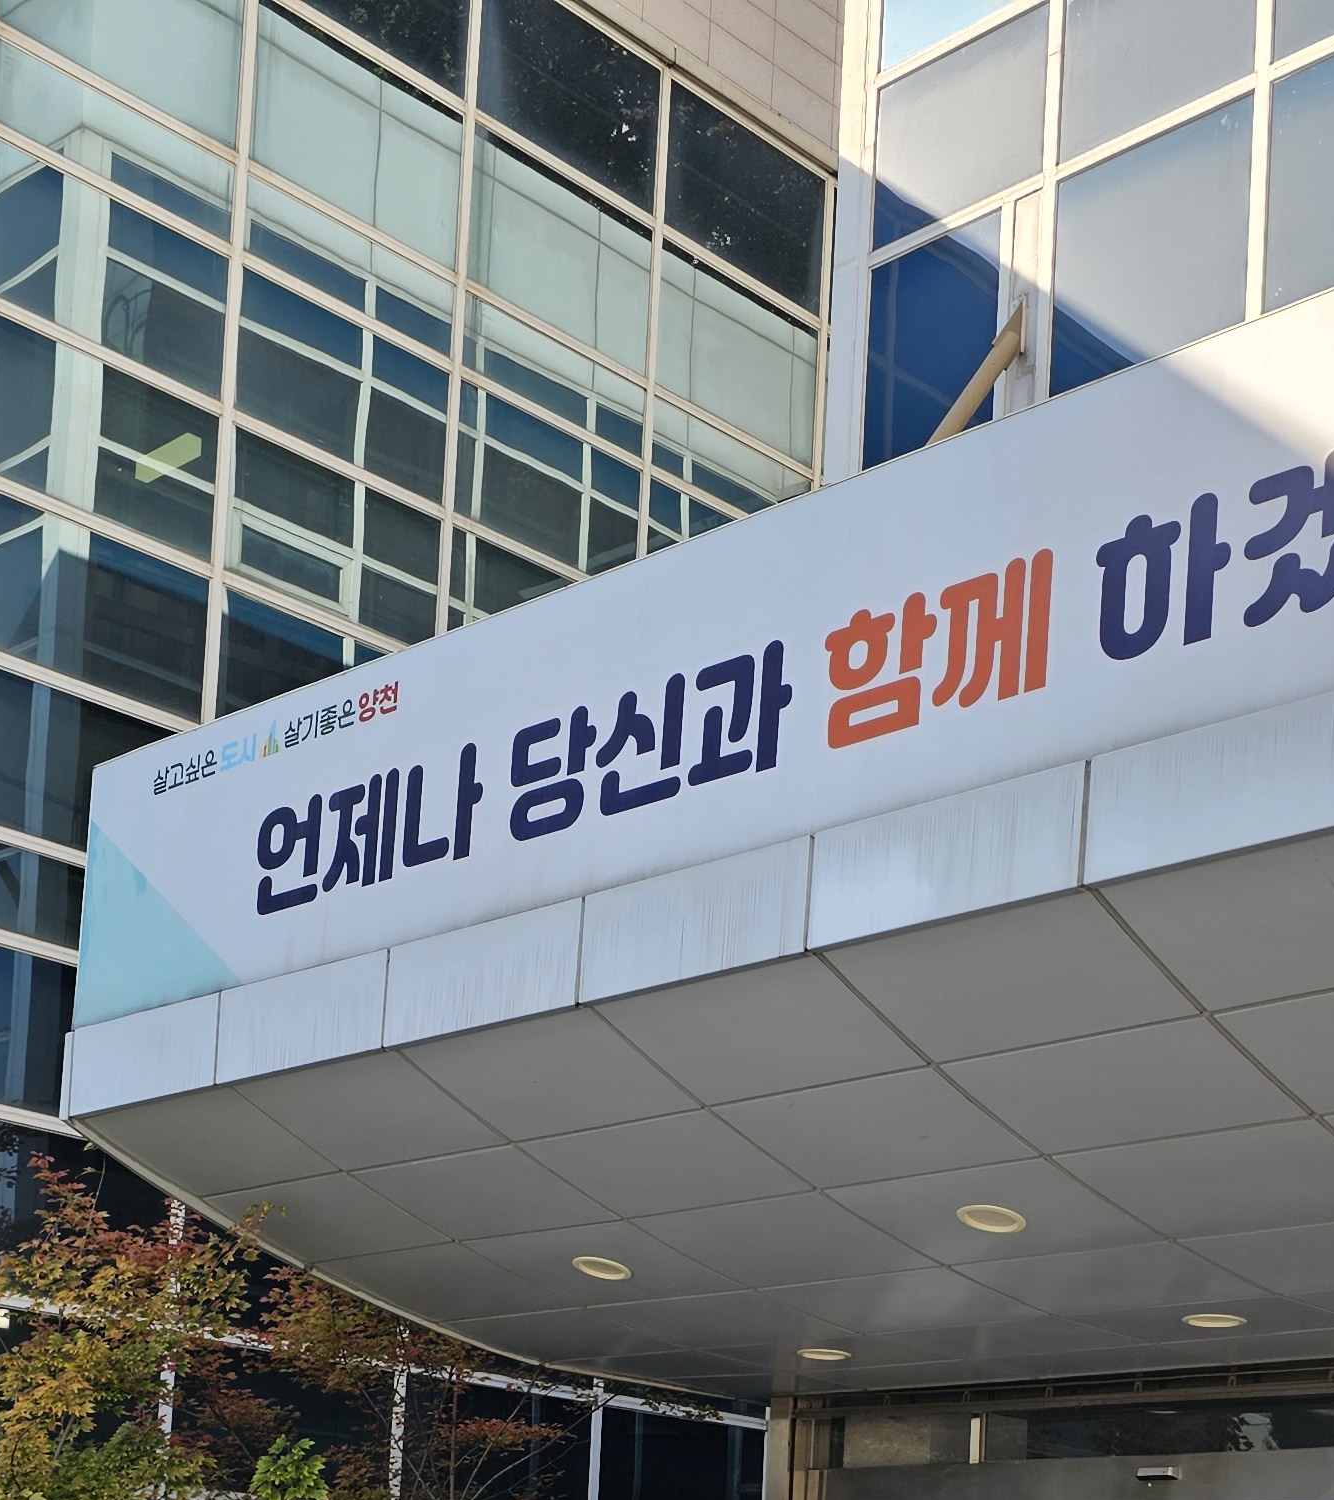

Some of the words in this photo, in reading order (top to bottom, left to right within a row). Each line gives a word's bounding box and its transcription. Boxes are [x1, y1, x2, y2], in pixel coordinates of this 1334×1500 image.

[153, 749, 217, 796] 살고싶은
[219, 733, 257, 773] 도시
[284, 698, 356, 749] 살기좋은
[358, 681, 399, 723] 양천
[256, 741, 484, 916] 언제나
[509, 639, 793, 842] 당신과
[825, 548, 1054, 750] 함께
